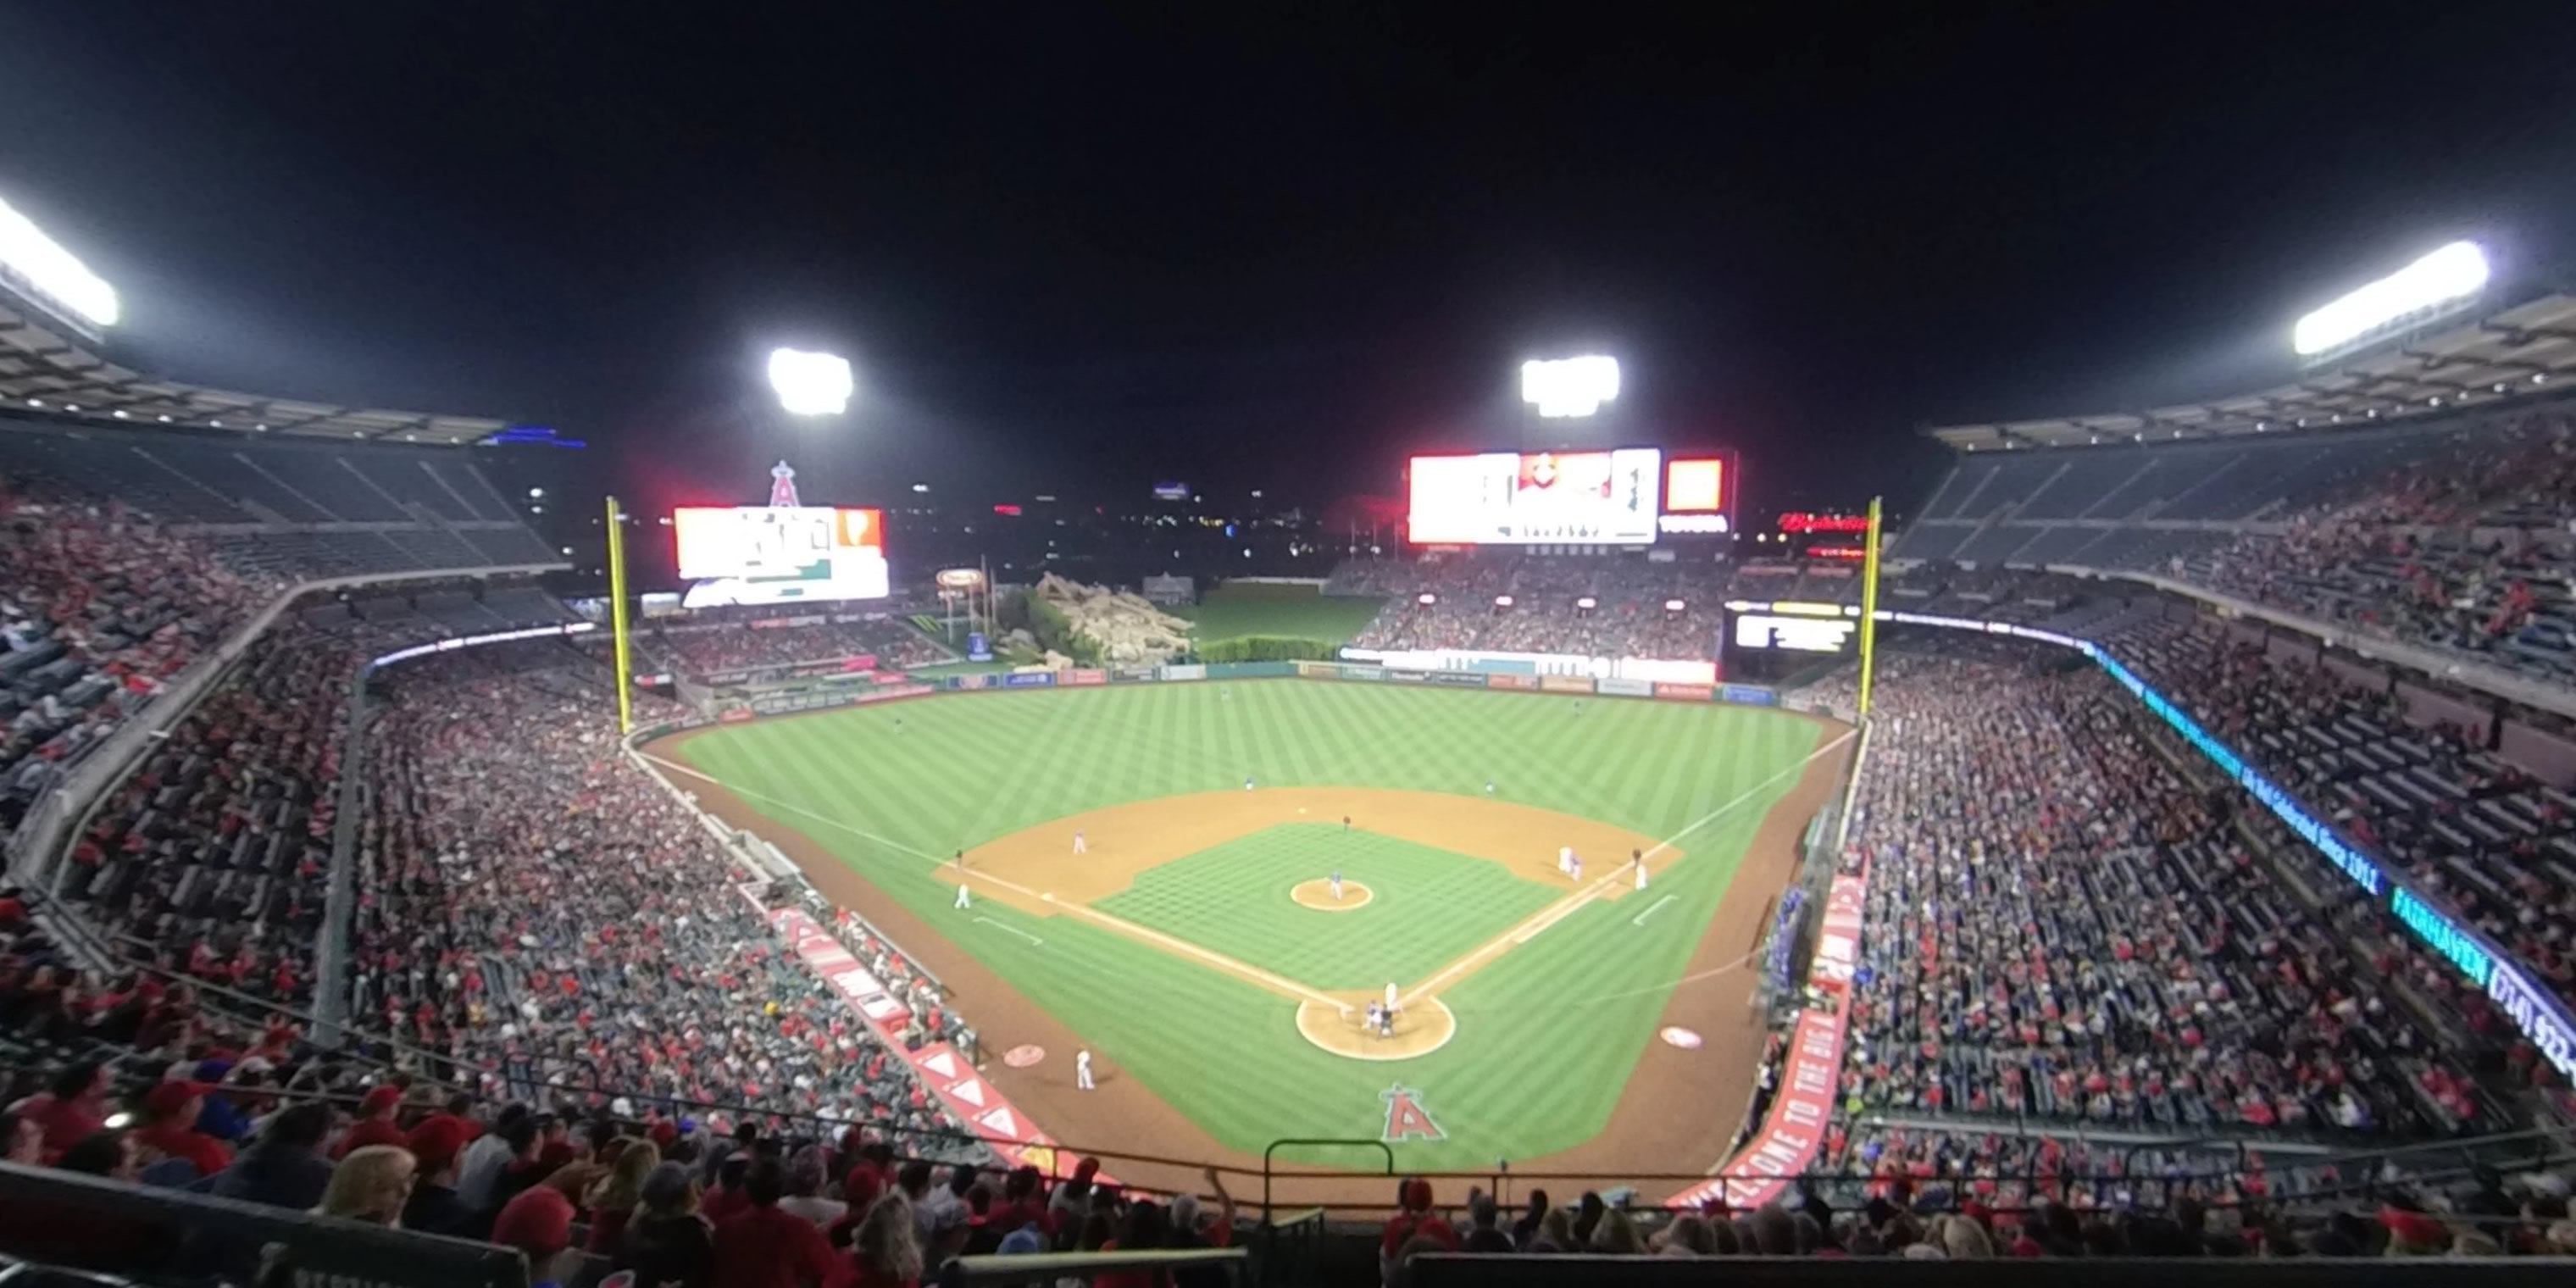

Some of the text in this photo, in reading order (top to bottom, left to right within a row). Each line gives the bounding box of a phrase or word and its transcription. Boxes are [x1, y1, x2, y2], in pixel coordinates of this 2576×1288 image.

[2392, 886, 2490, 985] FAIRHAVEN
[1793, 1058, 1829, 1095] THE
[1379, 1081, 1448, 1142] A
[1783, 1099, 1820, 1127] TO
